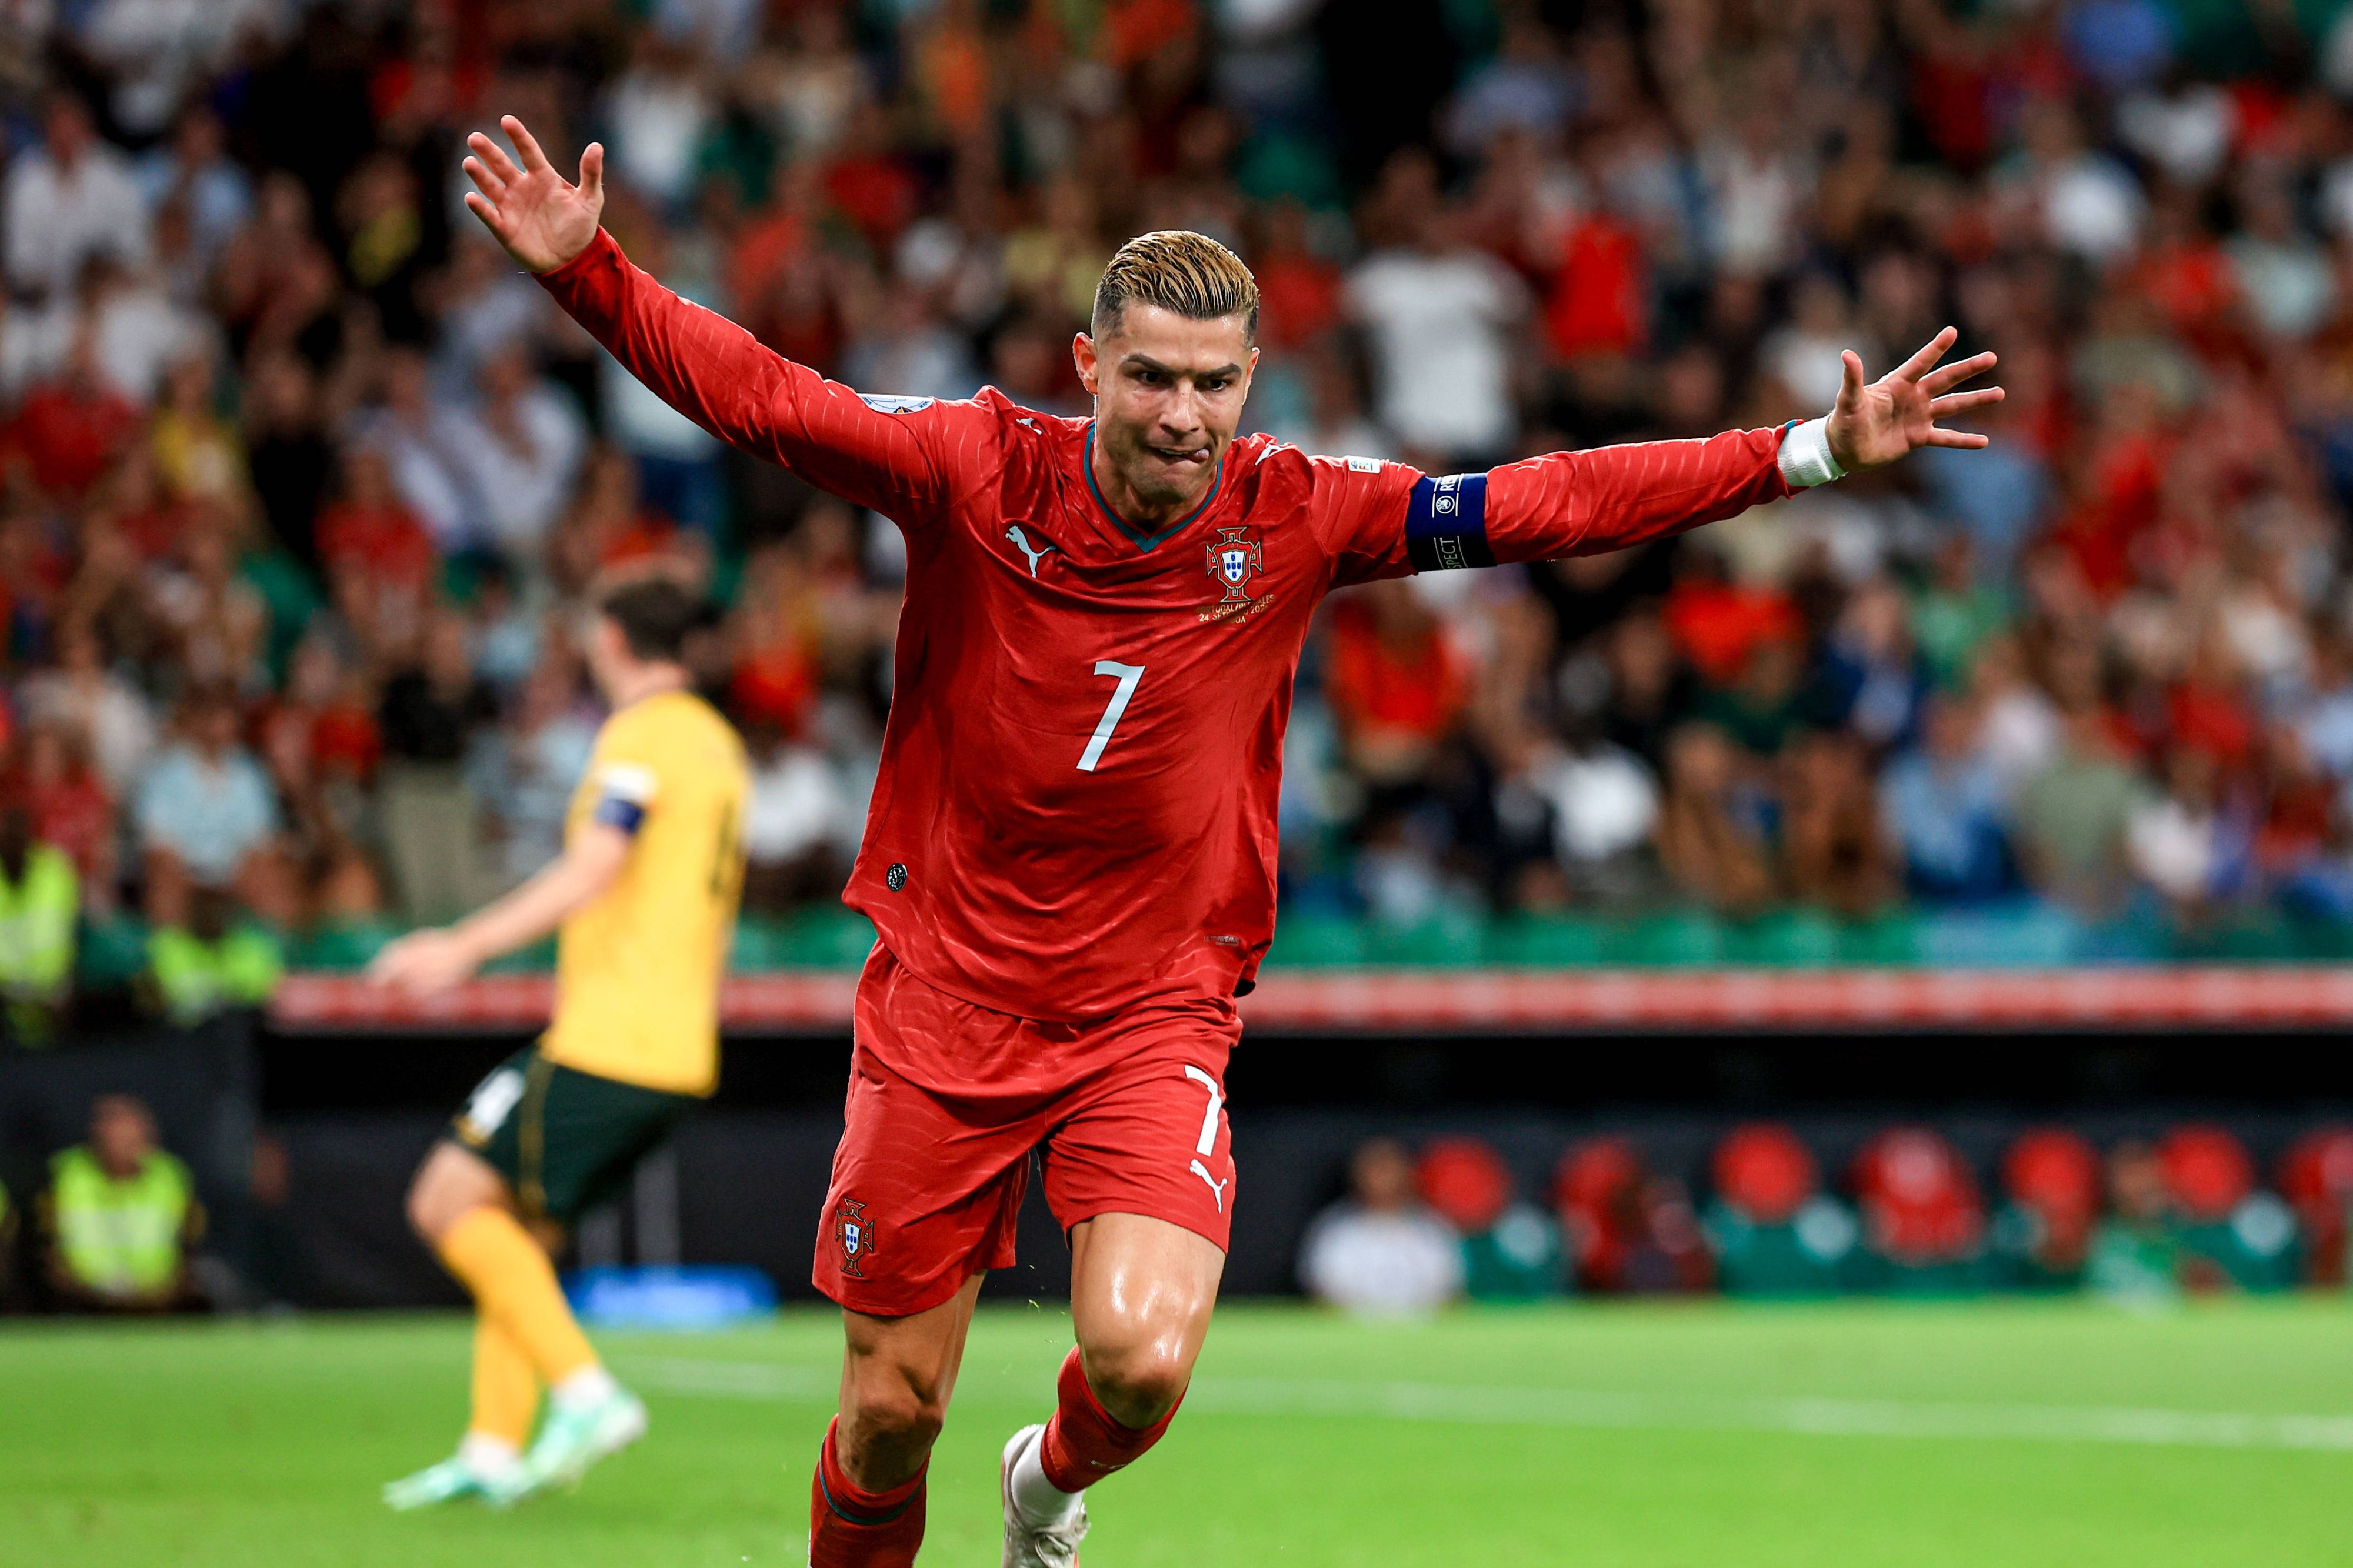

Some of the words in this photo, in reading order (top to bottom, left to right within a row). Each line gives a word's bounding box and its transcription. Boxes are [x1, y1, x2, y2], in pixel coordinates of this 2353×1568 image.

[1199, 613, 1209, 622] 24
[1076, 660, 1146, 772] 7
[1184, 1065, 1222, 1157] 7
